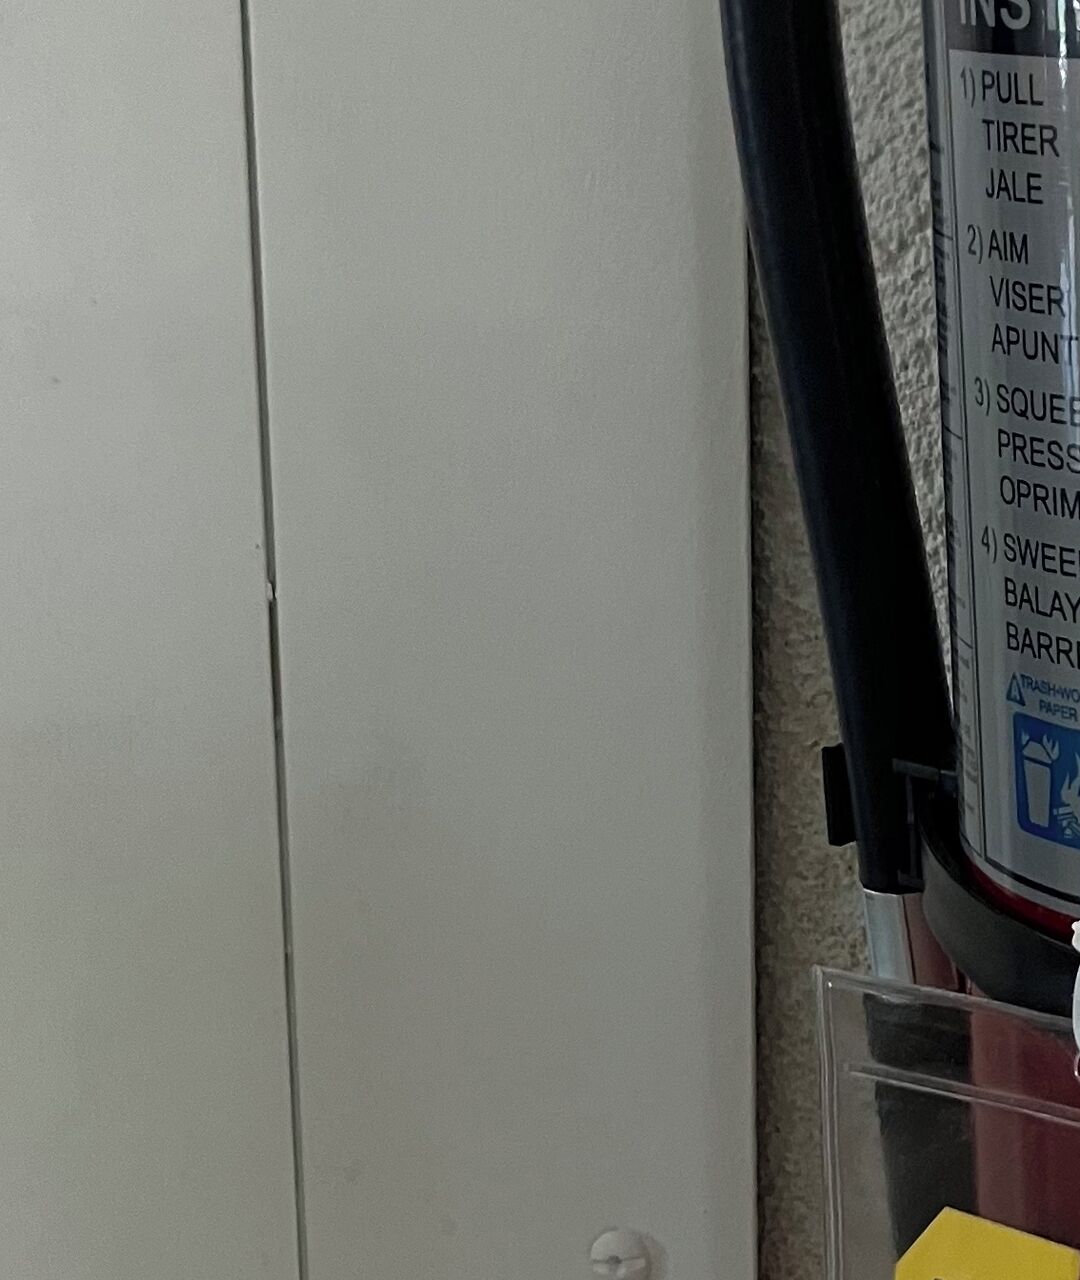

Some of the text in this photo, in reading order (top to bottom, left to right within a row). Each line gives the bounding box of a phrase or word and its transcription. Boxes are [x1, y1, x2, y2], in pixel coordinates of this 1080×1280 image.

[960, 69, 1044, 109] 1) PULL
[981, 118, 1060, 157] TIRER
[985, 168, 1044, 205] JALE
[967, 227, 1029, 265] 2) AIM
[989, 274, 1065, 316] VISER
[974, 377, 991, 417] 3)
[980, 527, 998, 564] 4)
[1038, 697, 1079, 721] PAPER
